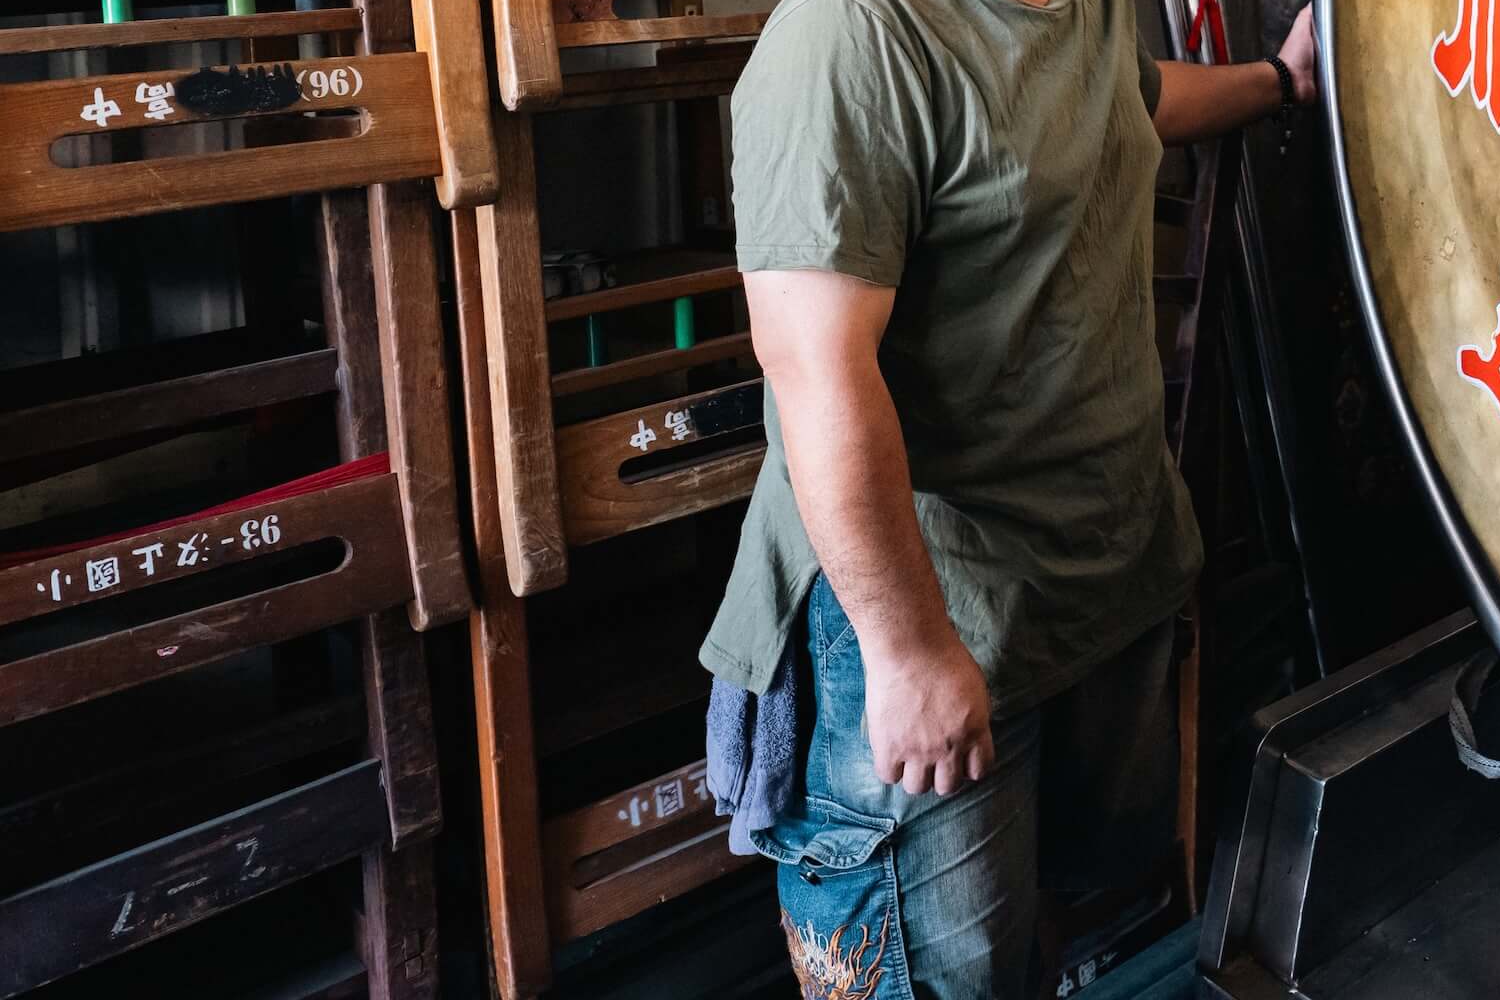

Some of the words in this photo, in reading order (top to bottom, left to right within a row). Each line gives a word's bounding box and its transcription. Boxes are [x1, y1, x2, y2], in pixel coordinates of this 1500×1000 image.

[80, 81, 175, 127] 高中
[296, 65, 364, 103] (96)
[629, 408, 691, 452] 高中
